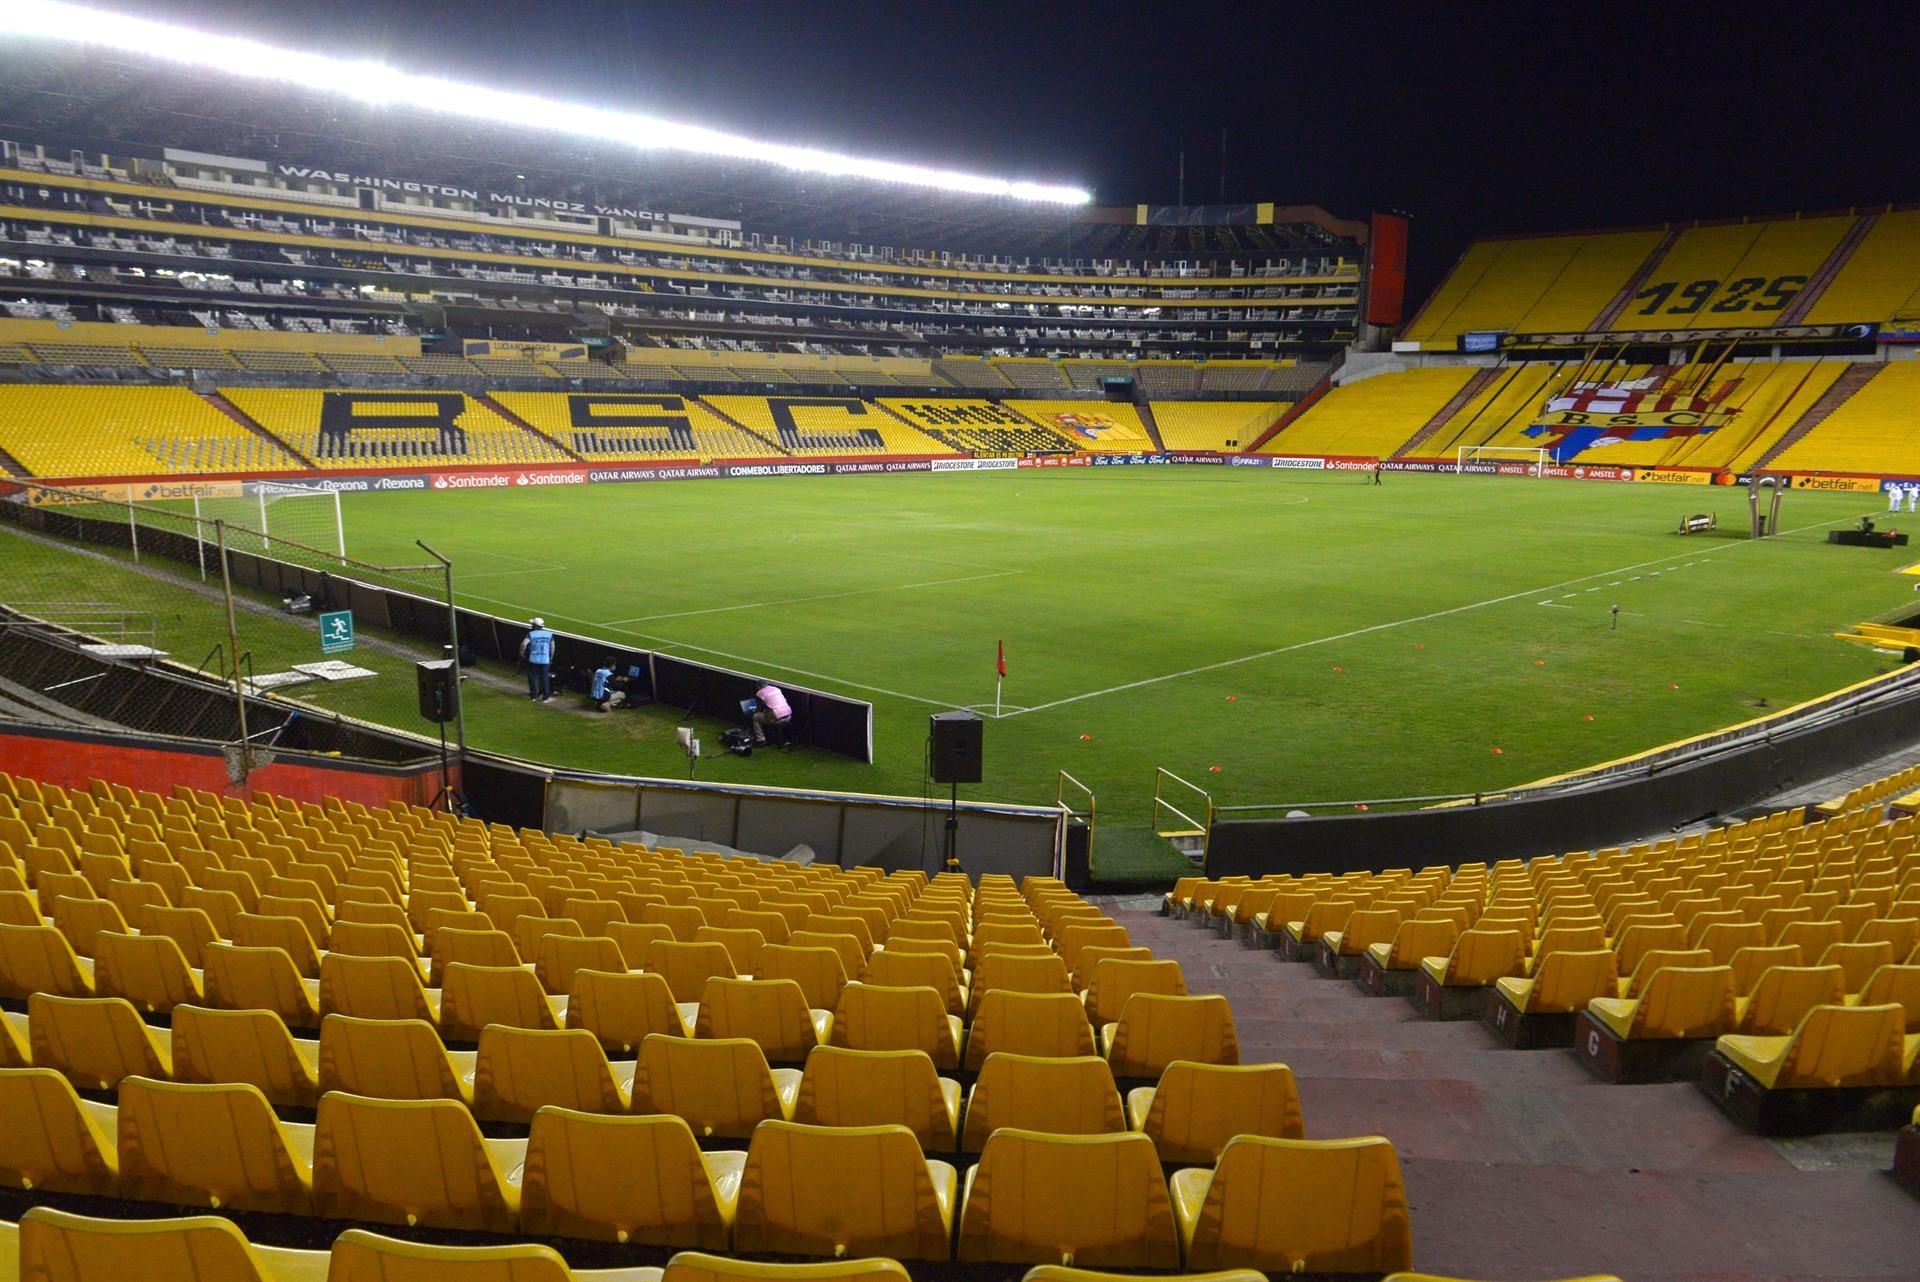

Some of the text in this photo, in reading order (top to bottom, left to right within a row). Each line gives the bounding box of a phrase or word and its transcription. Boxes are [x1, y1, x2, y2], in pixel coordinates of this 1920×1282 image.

[279, 165, 665, 221] WASHINGTON MUÑOZ YANCE
[1636, 275, 1808, 315] 1925
[977, 459, 1016, 469] BRIDGESTONE
[1094, 456, 1109, 465] Ford
[1111, 456, 1125, 465] Ford
[1129, 455, 1146, 464] Ford
[1148, 454, 1165, 464] Ford
[1171, 455, 1194, 463] QATAR
[1194, 456, 1223, 464] AIRWAYS
[1274, 458, 1324, 468] BRIDGESTONE
[730, 464, 825, 475] CONMEBOL LIBERTADORES
[835, 463, 884, 473] QATAR AIRWAYS
[886, 462, 931, 472] QATAR AIRWAYS
[932, 461, 975, 470] BRIDGESTONE
[1335, 460, 1376, 470] Santander
[1380, 463, 1435, 472] QATAR AIRWAYS
[1438, 464, 1496, 473] QATAR AIRWAYS
[590, 470, 655, 482] QATAR AIRWAYS
[658, 467, 719, 479] QATAR AIRWAYS
[1542, 468, 1568, 476] AMSTEL
[1589, 470, 1616, 478] AMSTEL
[382, 477, 424, 490] Rexona
[449, 476, 510, 488] Santander
[530, 473, 585, 486] Santander
[324, 479, 368, 492] Rexona
[1588, 1030, 1599, 1056] G
[1725, 1071, 1740, 1098] F
